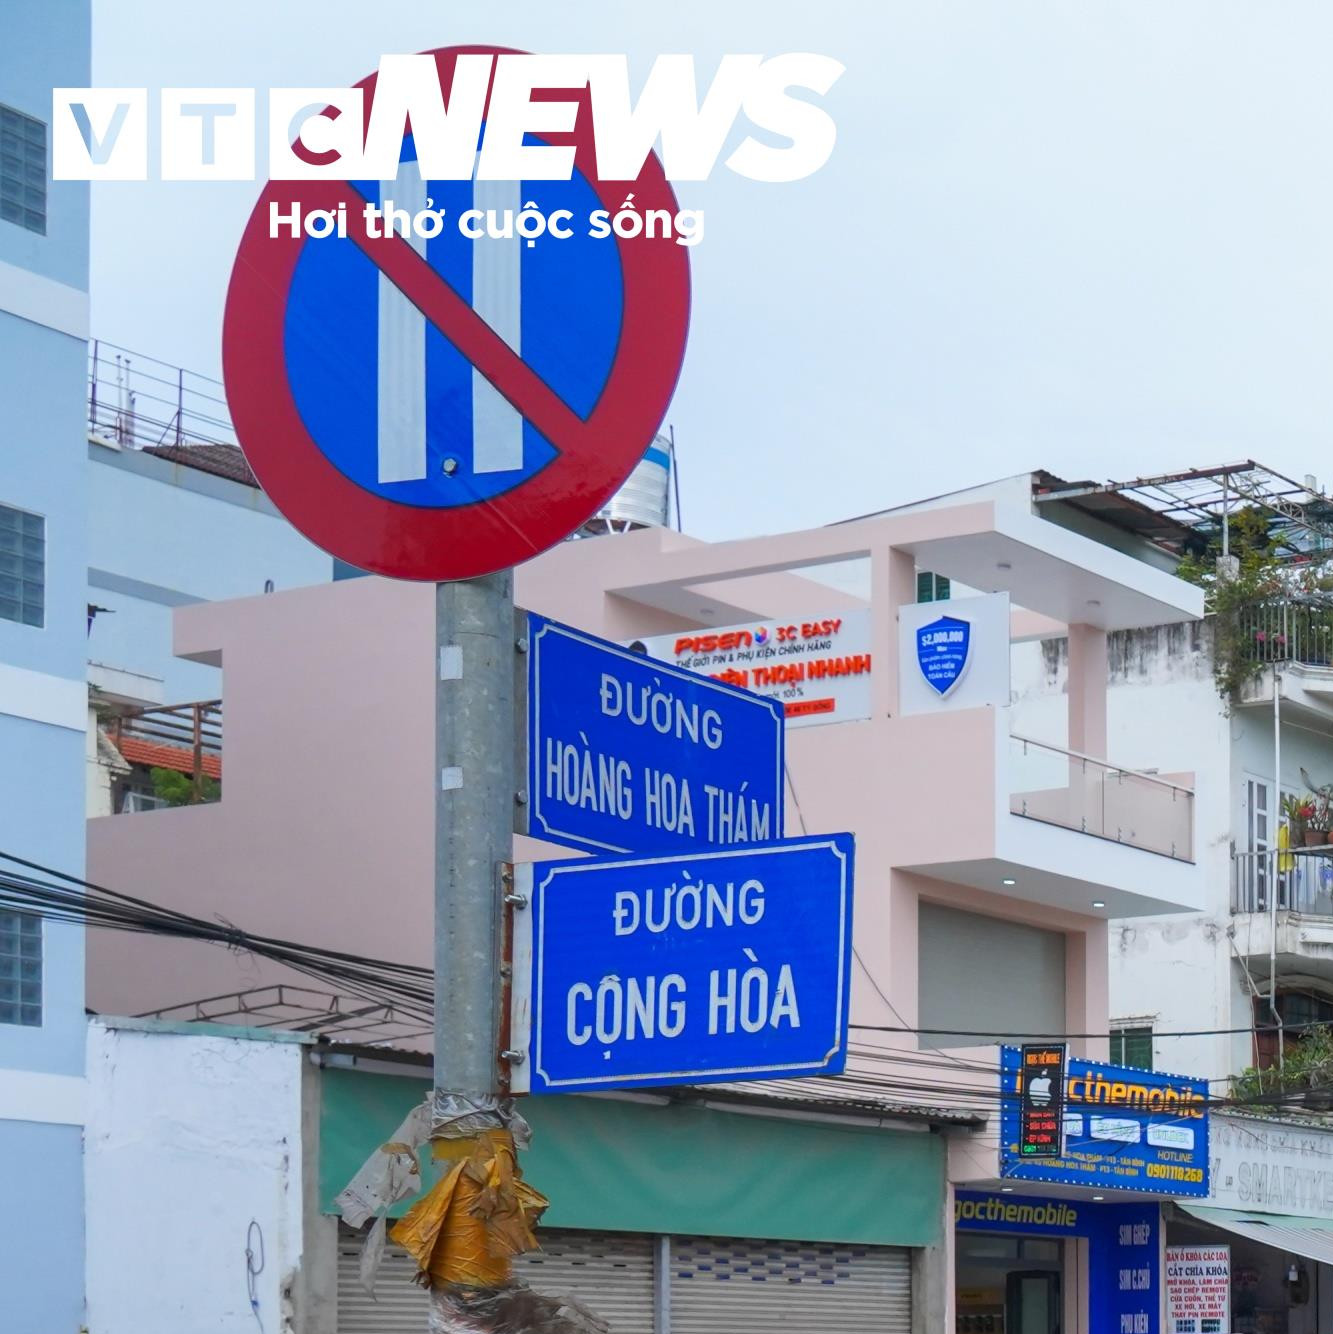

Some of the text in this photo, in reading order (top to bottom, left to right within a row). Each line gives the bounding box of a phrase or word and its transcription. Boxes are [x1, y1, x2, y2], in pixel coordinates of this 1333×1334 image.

[775, 626, 798, 643] 3C
[801, 619, 842, 641] EASY
[712, 654, 727, 665] PIN
[736, 648, 753, 662] PHỤ
[756, 646, 777, 660] KIỆN
[778, 642, 805, 657] CHÍNH
[806, 640, 832, 651] HÃNG
[752, 664, 805, 689] THOẠI
[807, 654, 872, 680] NHANH
[599, 672, 723, 750] ĐƯỜNG
[546, 731, 770, 844] HOÀNG HOA THÁM
[612, 869, 766, 937] ĐƯỜNG
[566, 947, 802, 1061] CỘNG HÒA
[1157, 1151, 1194, 1163] HOTLINE
[1119, 1270, 1131, 1290] SIM
[1168, 1262, 1228, 1276] CẮT CHÌA KHÓA
[1207, 1302, 1222, 1310] MÁY
